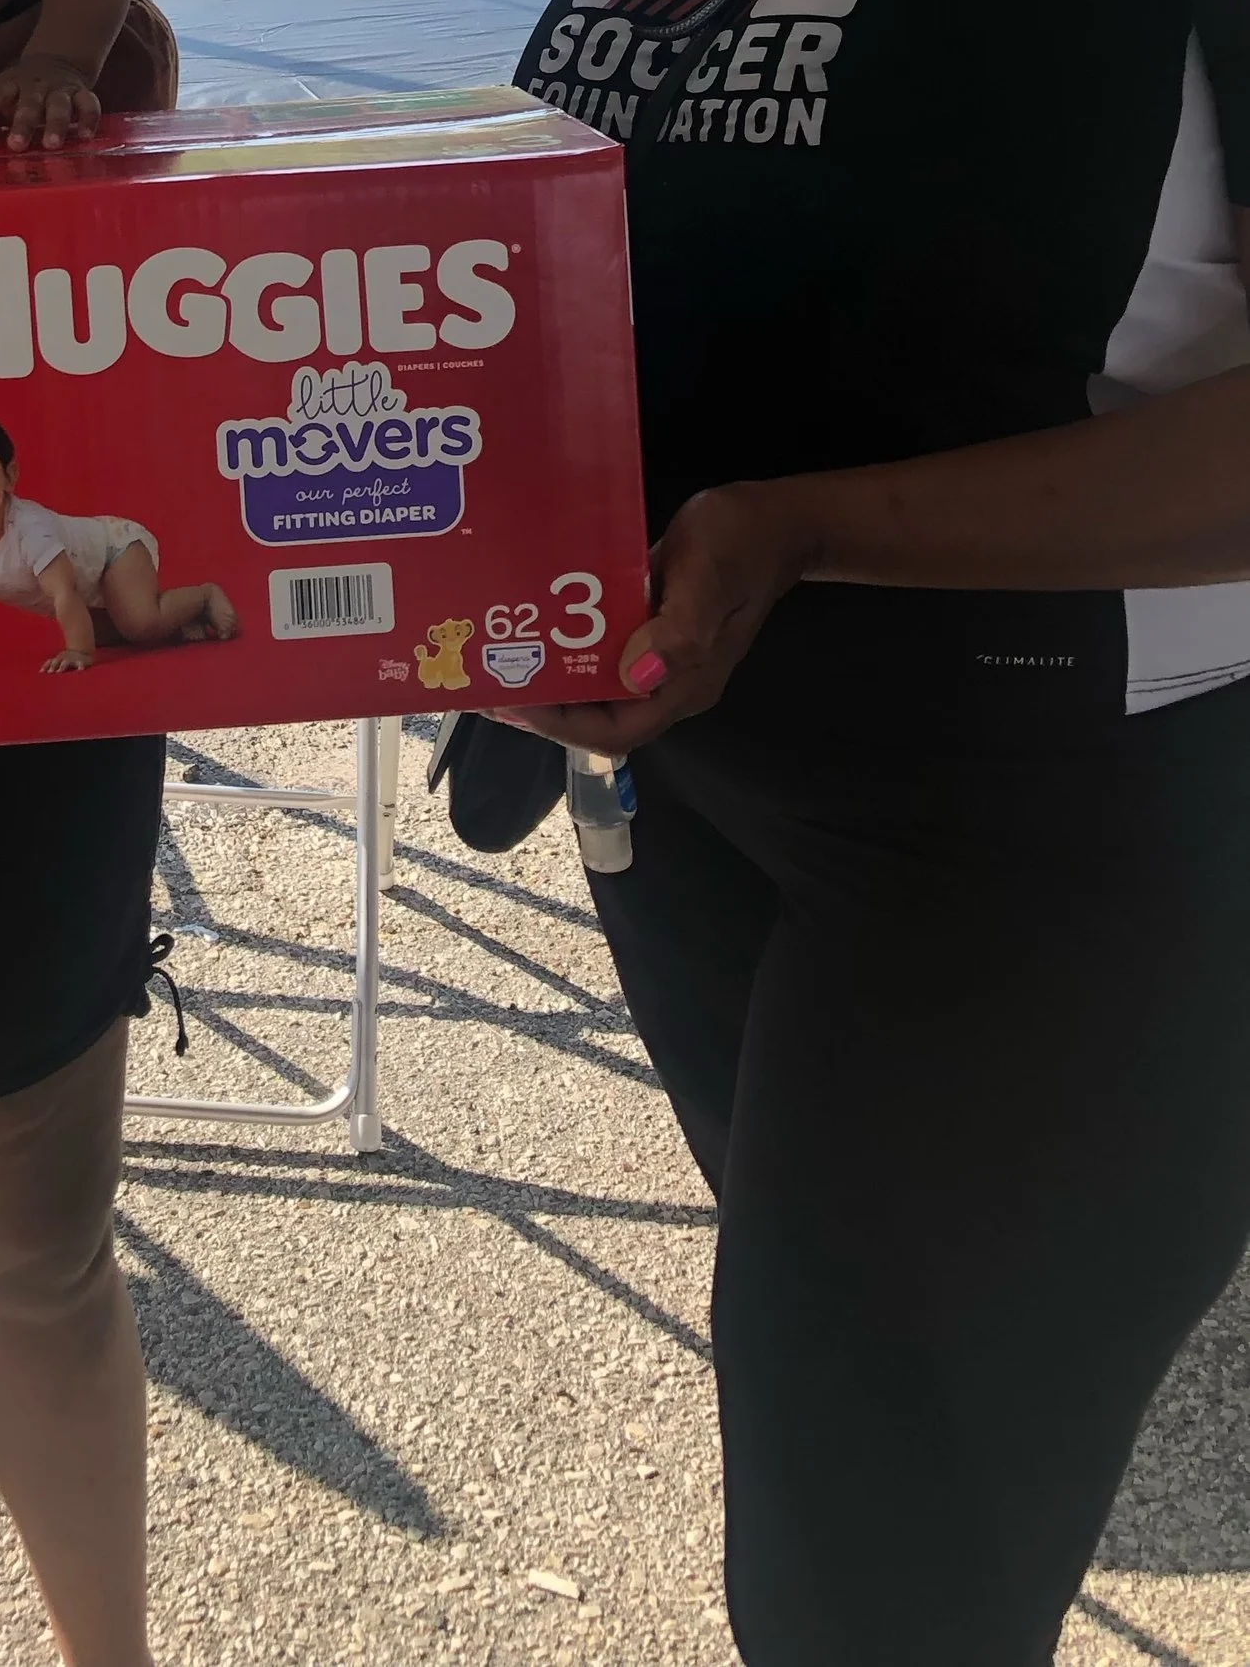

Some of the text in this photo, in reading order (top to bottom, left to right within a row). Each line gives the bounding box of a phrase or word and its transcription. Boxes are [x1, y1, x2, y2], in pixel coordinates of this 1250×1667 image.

[397, 359, 484, 372] DIAPERS COUCHES
[296, 370, 398, 420] little
[226, 415, 473, 470] movers
[296, 478, 411, 506] our perfect
[273, 505, 436, 530] FITTING DIAPER
[485, 603, 540, 640] 62
[550, 572, 606, 649] 3
